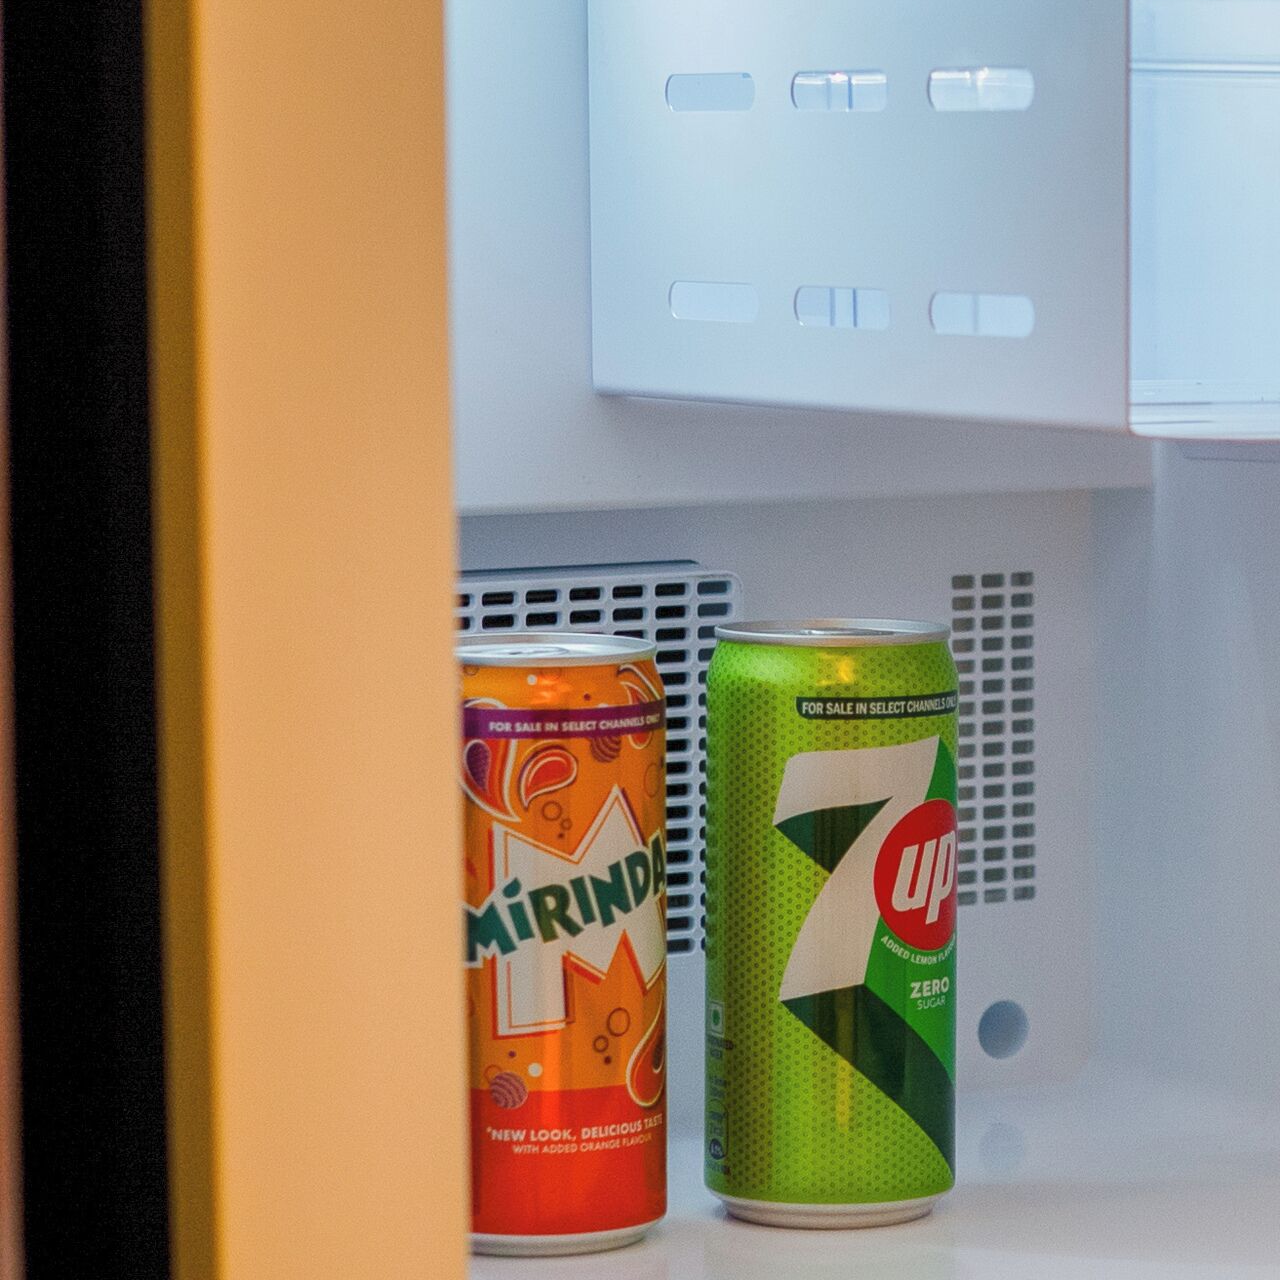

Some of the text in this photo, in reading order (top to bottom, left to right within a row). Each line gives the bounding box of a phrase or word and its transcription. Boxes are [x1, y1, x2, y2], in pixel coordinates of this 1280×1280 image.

[802, 701, 824, 716] FOR
[826, 701, 854, 716] SALE
[855, 701, 868, 715] IN
[869, 700, 906, 715] SELECT
[907, 697, 945, 713] CHANNELS
[489, 721, 513, 733] FOR
[515, 721, 542, 733] SALE
[544, 721, 559, 732] IN
[561, 719, 598, 732] SELECT
[599, 716, 645, 731] CHANNELS
[881, 935, 911, 960] ADDED
[911, 954, 938, 965] LEMON
[909, 976, 950, 999] ZERO
[917, 996, 946, 1010] SUGAR
[530, 1127, 577, 1143] LOOK,
[580, 1120, 642, 1139] DELICIOUS
[512, 1143, 540, 1155] WITH
[542, 1142, 578, 1155] ADDED
[579, 1138, 621, 1154] ORANGE
